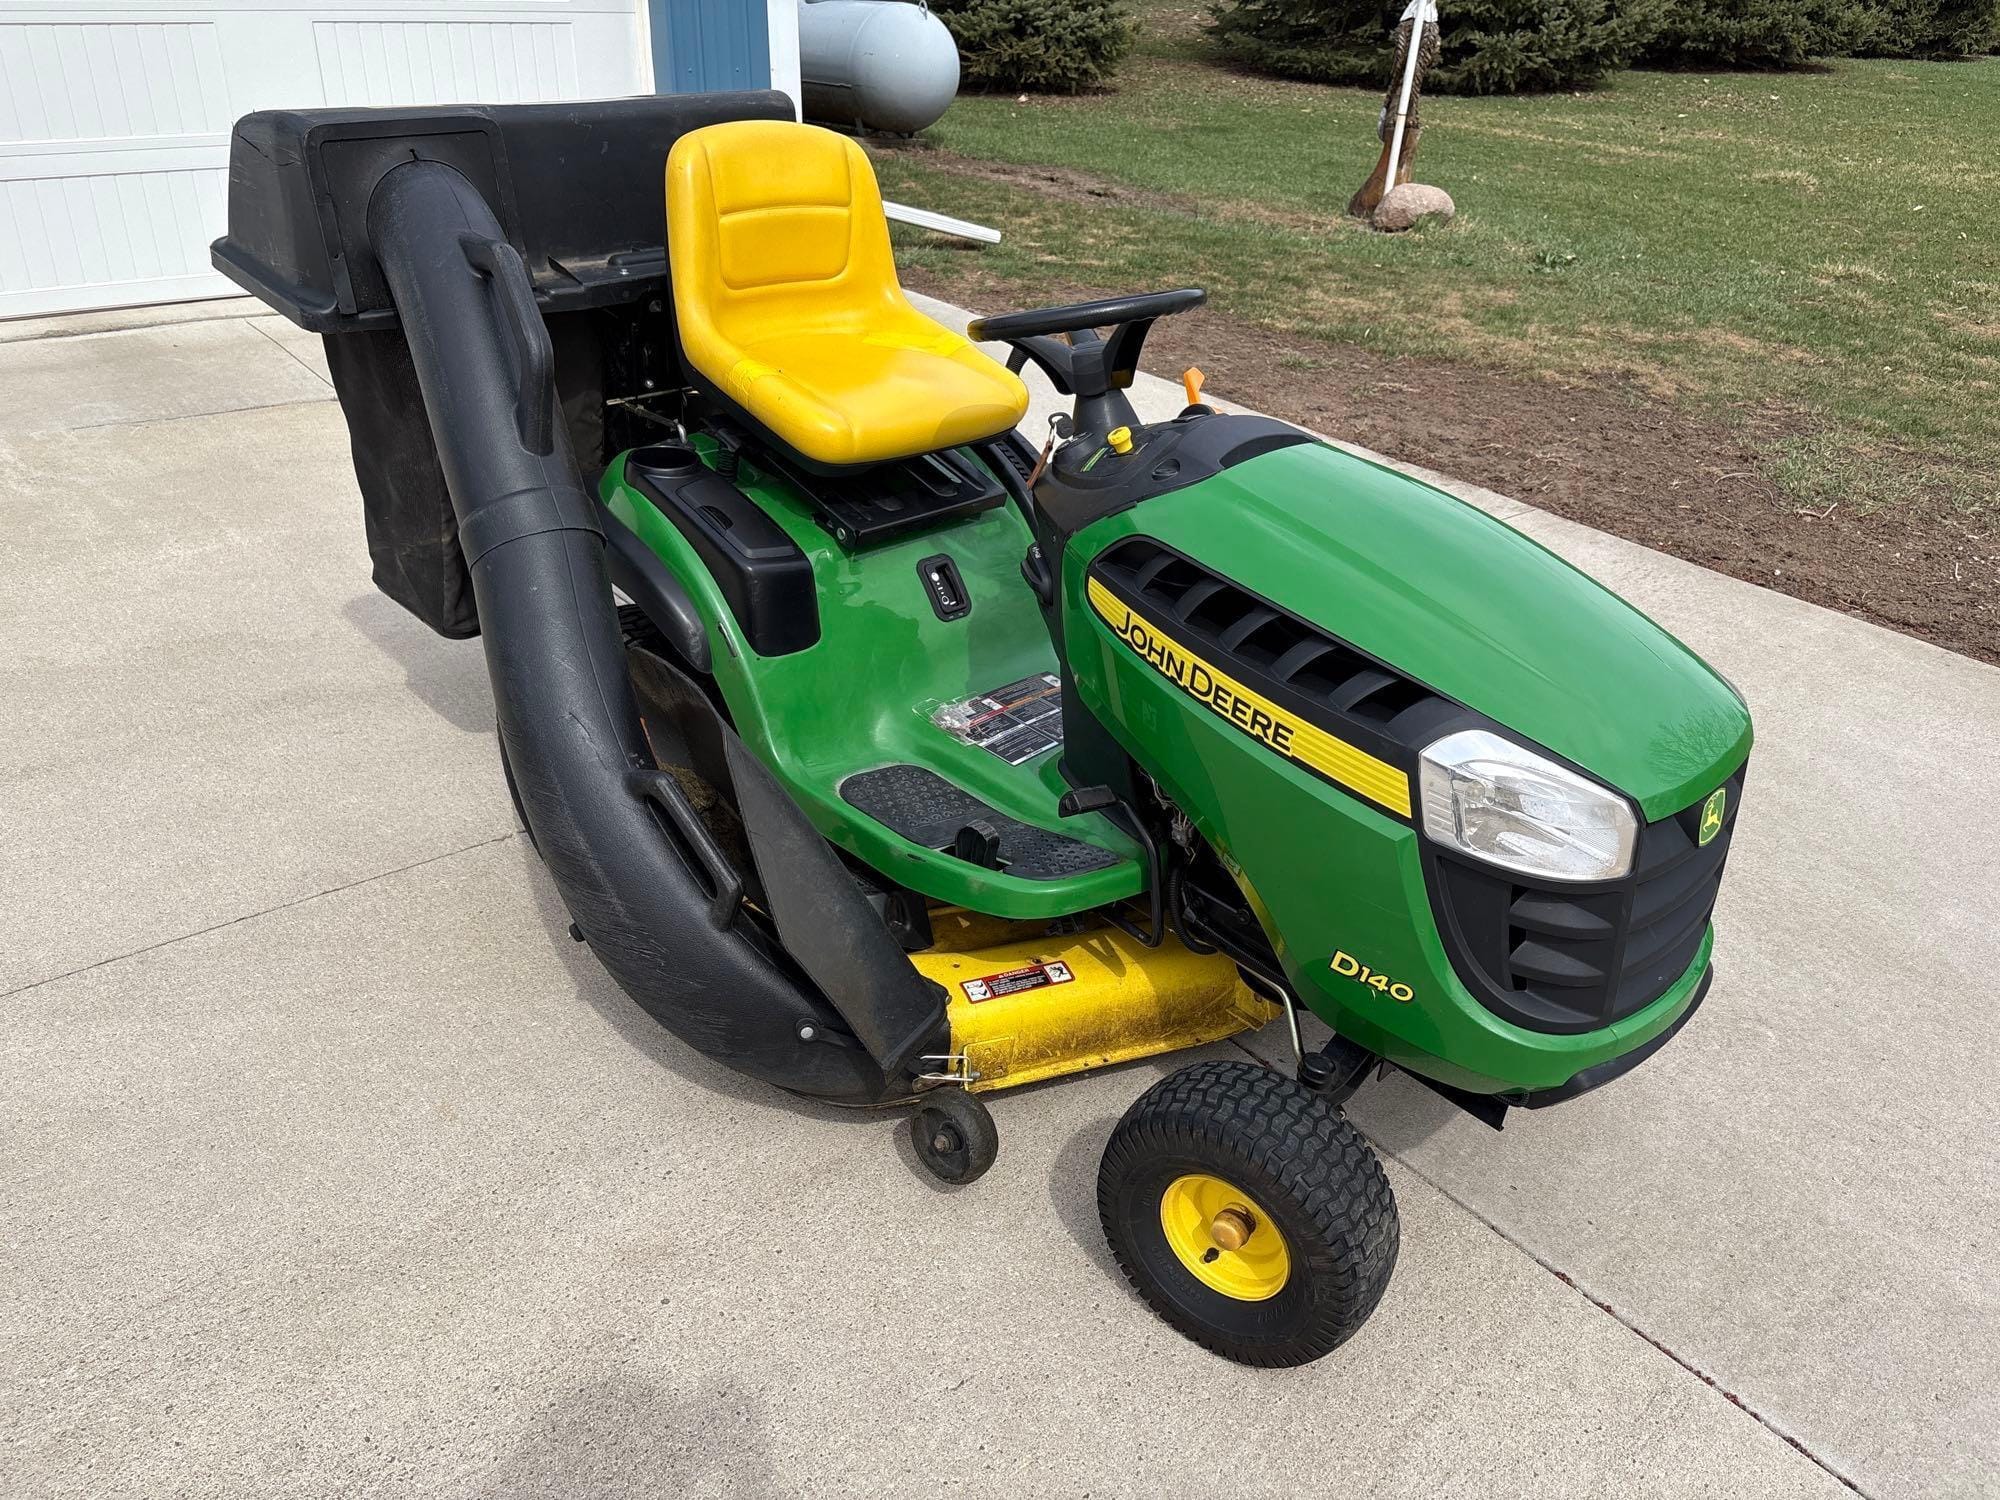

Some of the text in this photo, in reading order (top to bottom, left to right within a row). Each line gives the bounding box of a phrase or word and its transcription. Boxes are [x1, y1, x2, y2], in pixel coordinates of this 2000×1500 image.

[1115, 611, 1294, 753] JOHN DEERE
[1329, 949, 1415, 1002] D140
